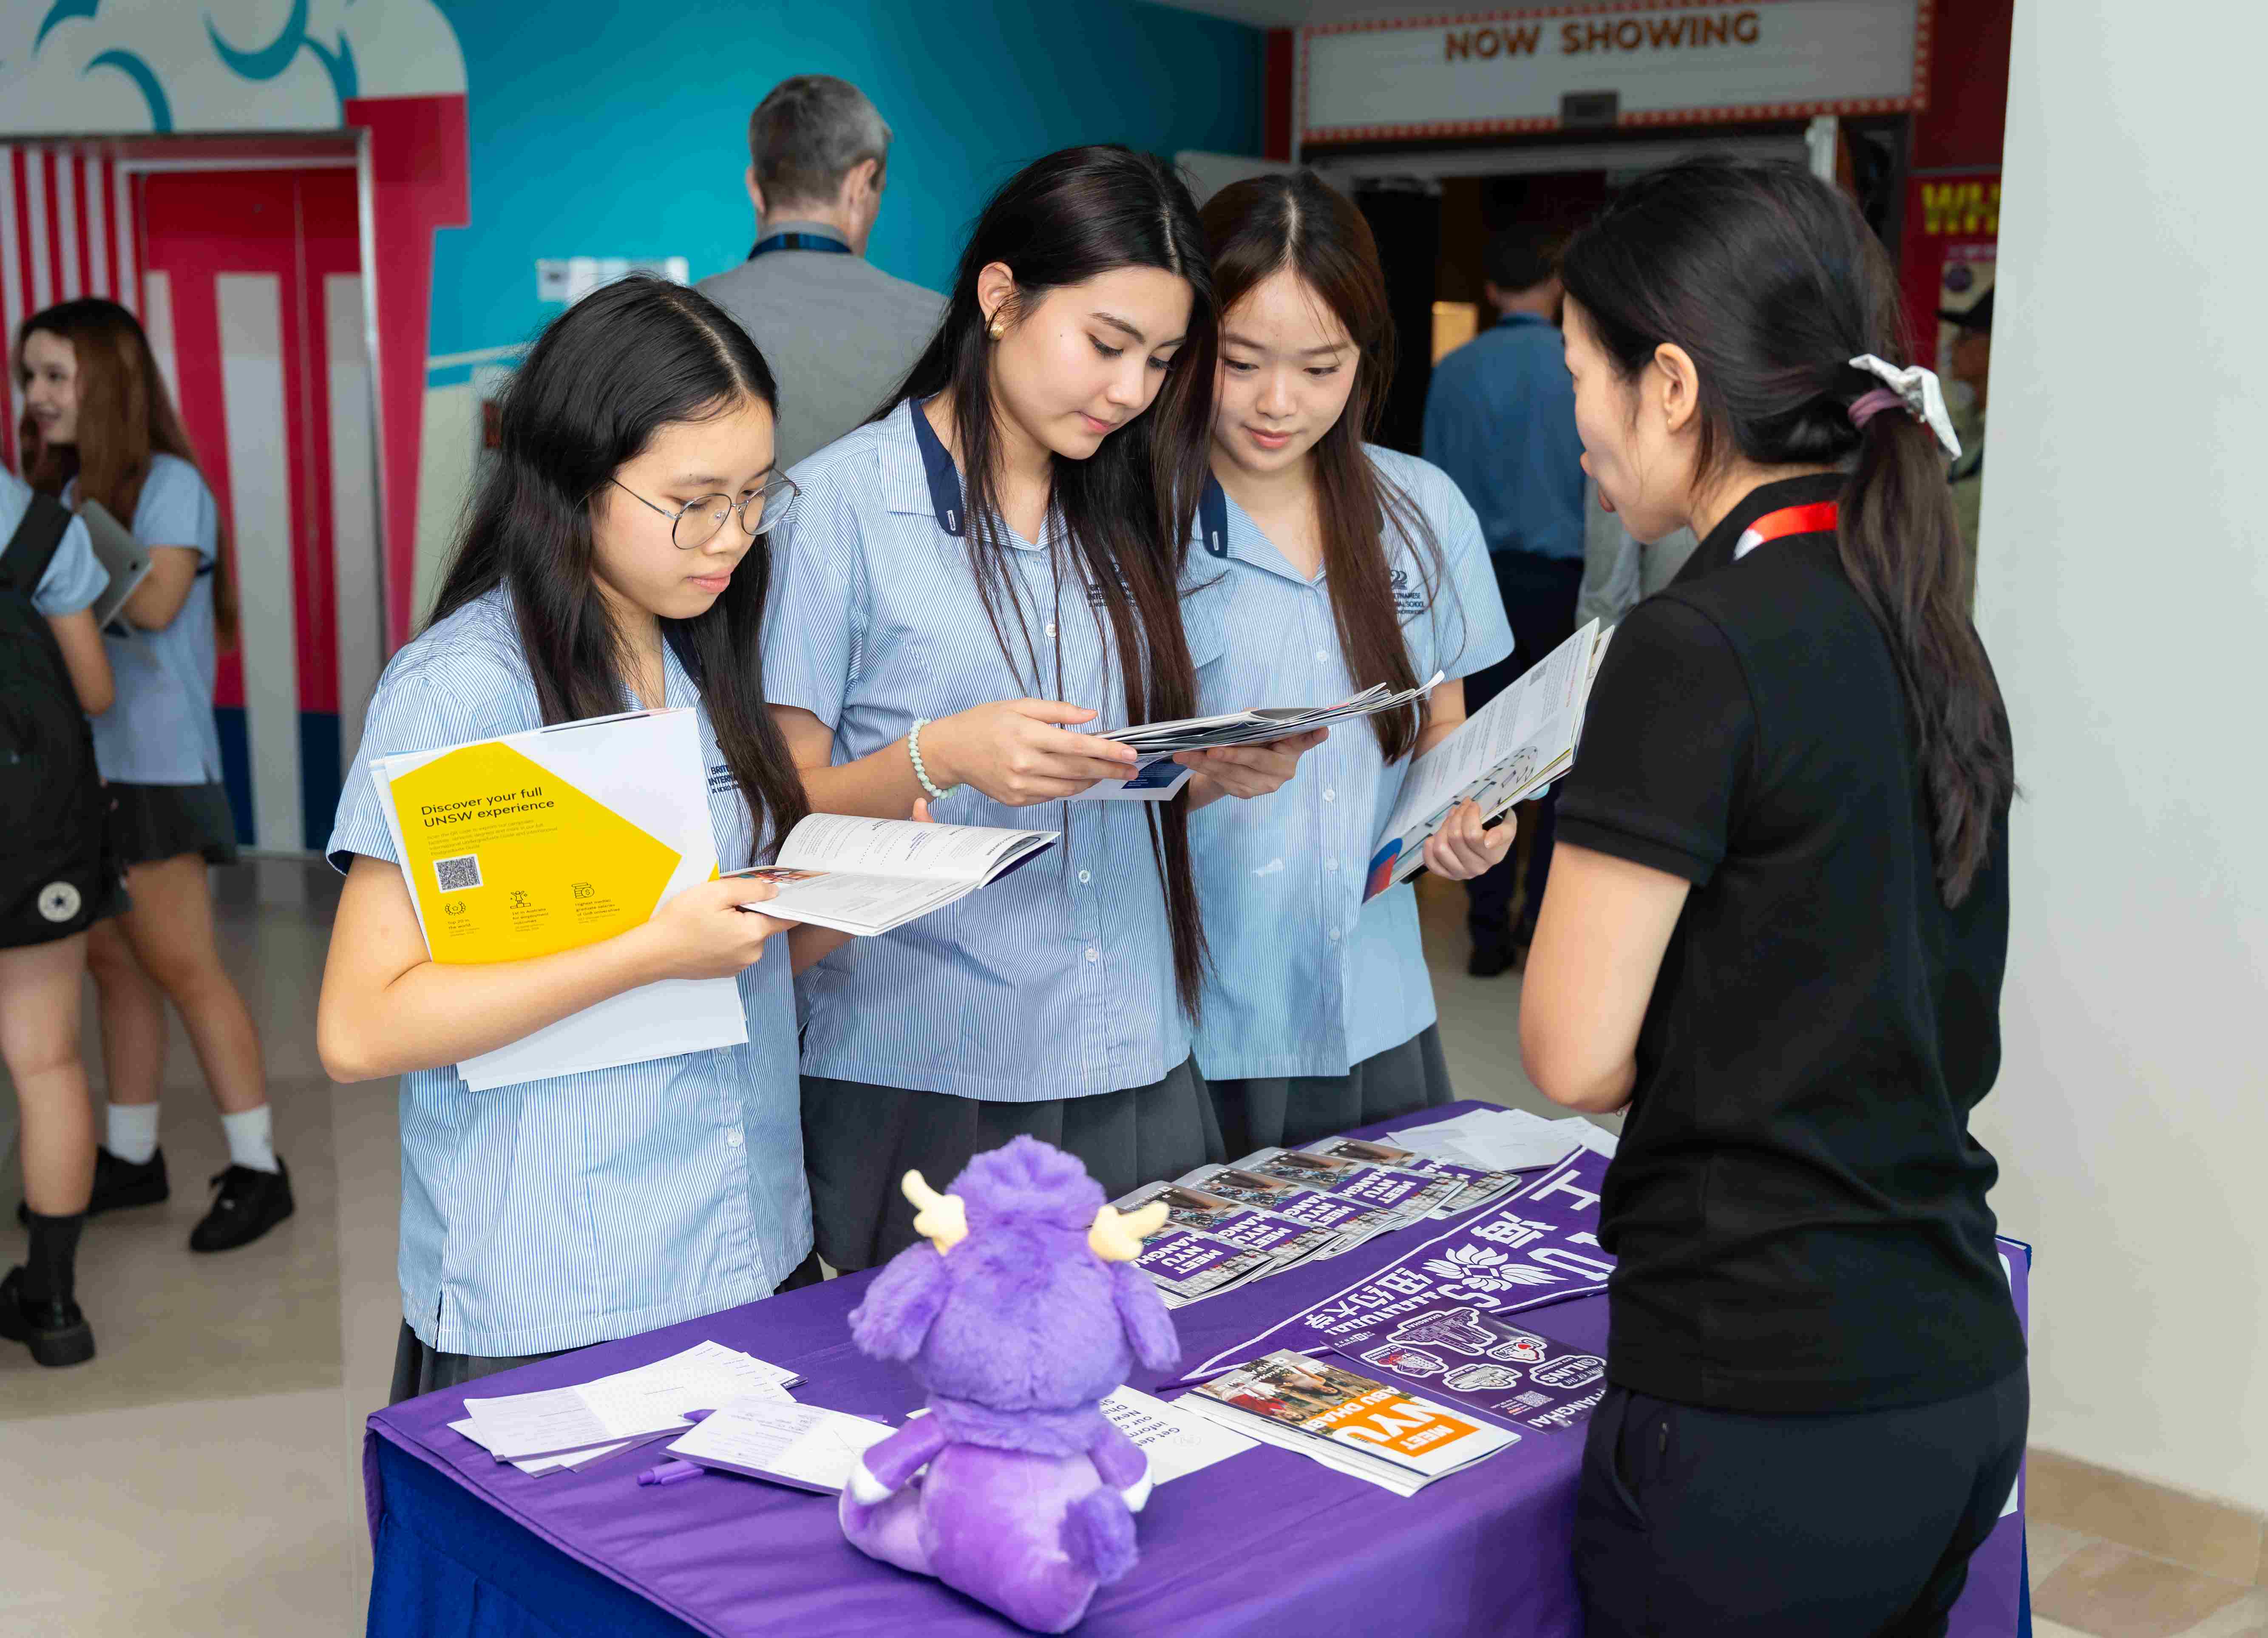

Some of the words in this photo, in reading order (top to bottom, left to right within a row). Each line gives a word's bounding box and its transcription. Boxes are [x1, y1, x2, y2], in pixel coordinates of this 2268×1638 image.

[1446, 24, 1541, 60] NOW
[1560, 11, 1760, 55] SHOWING
[711, 765, 729, 775] BRIT
[421, 798, 482, 816] Discover
[486, 792, 517, 806] your
[520, 786, 543, 798] full
[424, 810, 472, 828] UNSW
[478, 800, 554, 818] experience
[1362, 1179, 1398, 1198] NYU
[1377, 1180, 1417, 1204] MEET
[1160, 1245, 1205, 1267] NYU
[1173, 1249, 1225, 1275] MEET
[1406, 1314, 1442, 1329] SHANGHAI
[1360, 1386, 1401, 1406] ABU
[1527, 1387, 1607, 1428] HANGHAI
[1112, 1410, 1142, 1422] New
[1132, 1416, 1152, 1425] our
[1299, 1402, 1366, 1430] DHABI
[1332, 1403, 1443, 1442] NYU
[1156, 1428, 1180, 1438] Get
[1399, 1424, 1455, 1451] MEET
